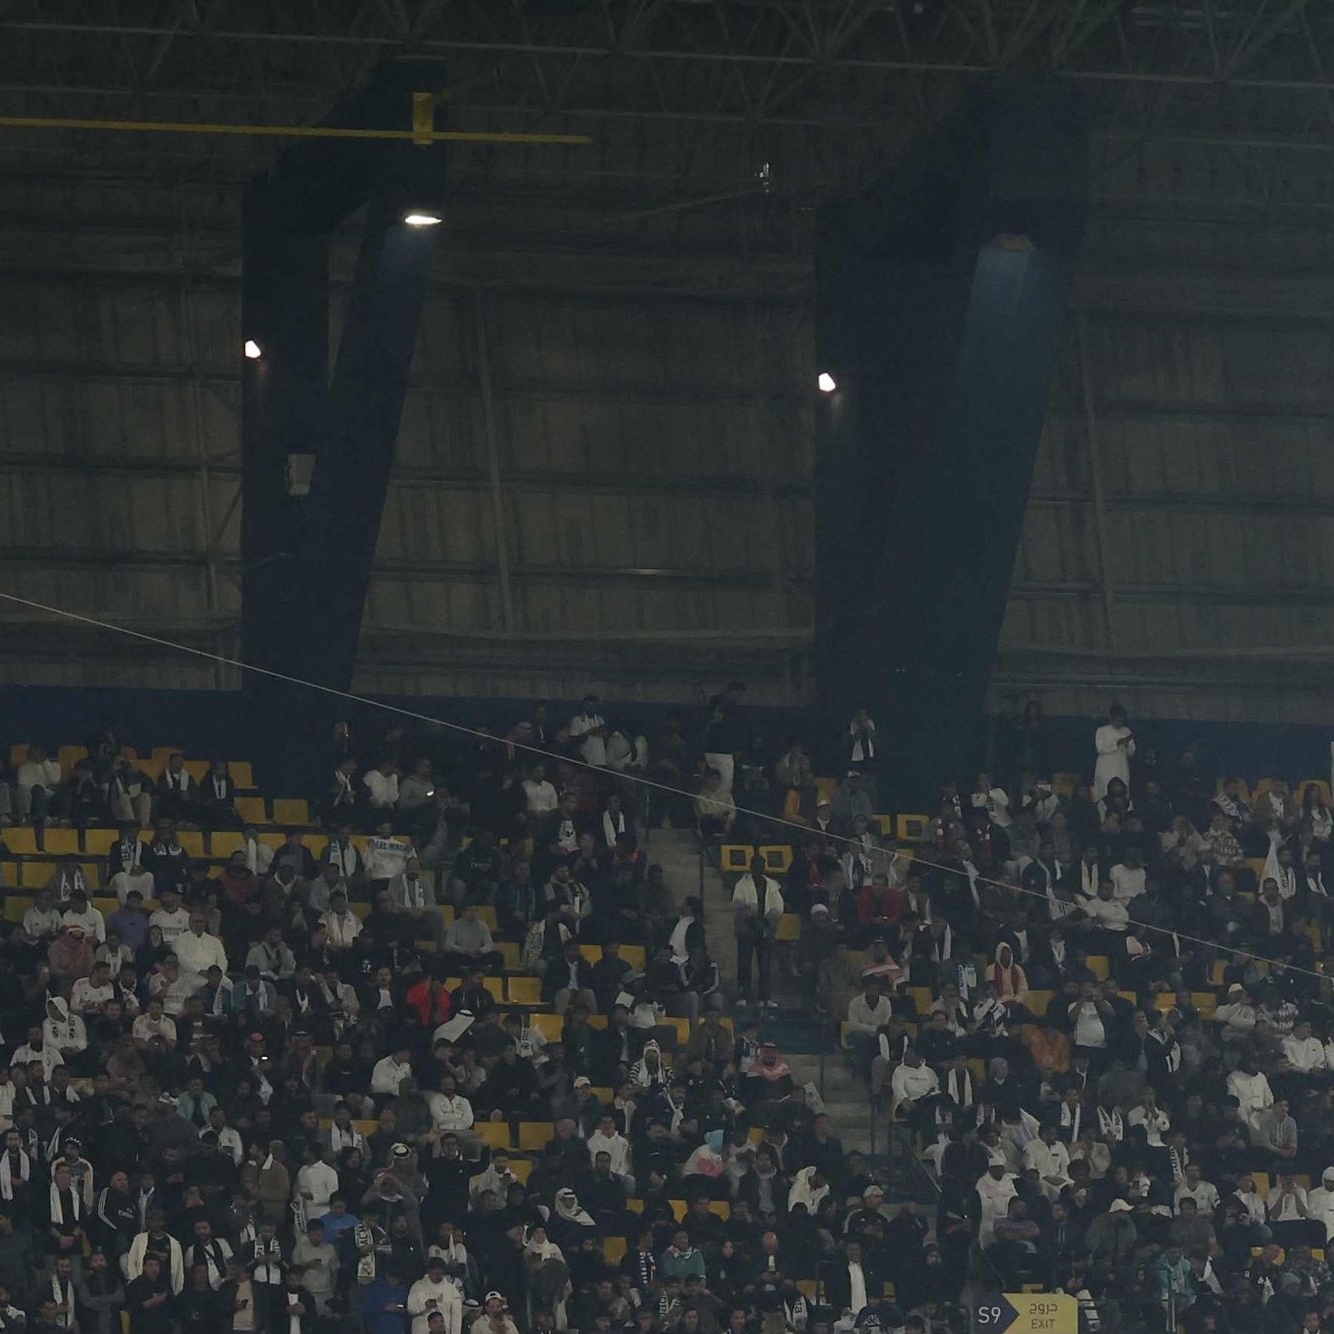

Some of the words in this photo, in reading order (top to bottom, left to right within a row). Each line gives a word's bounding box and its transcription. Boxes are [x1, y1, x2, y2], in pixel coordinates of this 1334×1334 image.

[978, 1306, 1002, 1324] S9
[1030, 1303, 1058, 1315] خروج
[1031, 1318, 1056, 1330] EXIT
